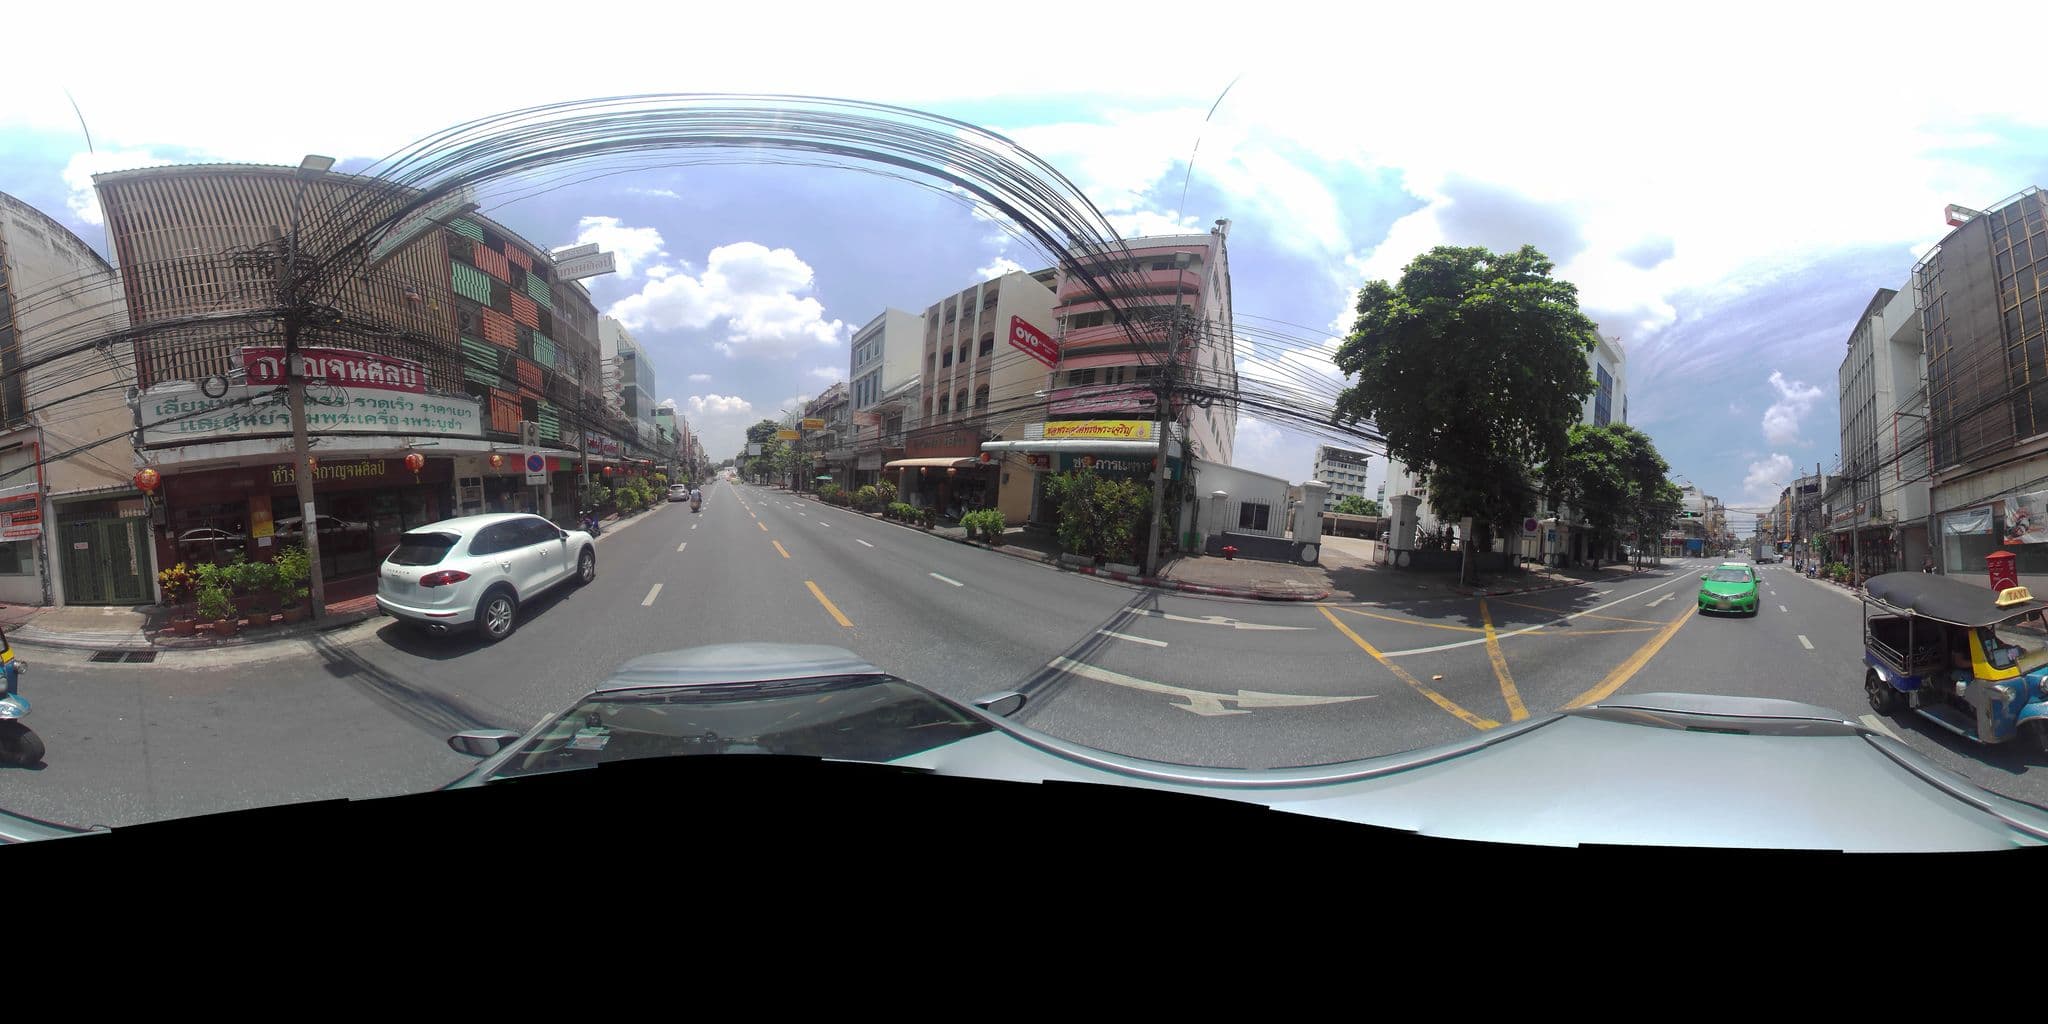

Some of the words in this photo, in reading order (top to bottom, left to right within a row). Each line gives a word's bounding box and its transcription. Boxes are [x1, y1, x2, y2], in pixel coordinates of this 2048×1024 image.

[1015, 326, 1039, 347] OYO
[257, 356, 417, 388] กญจนศิลป์
[180, 408, 463, 432] และศูนย์รมพระเครื่องพระบูชา
[2008, 589, 2028, 601] TAXI
